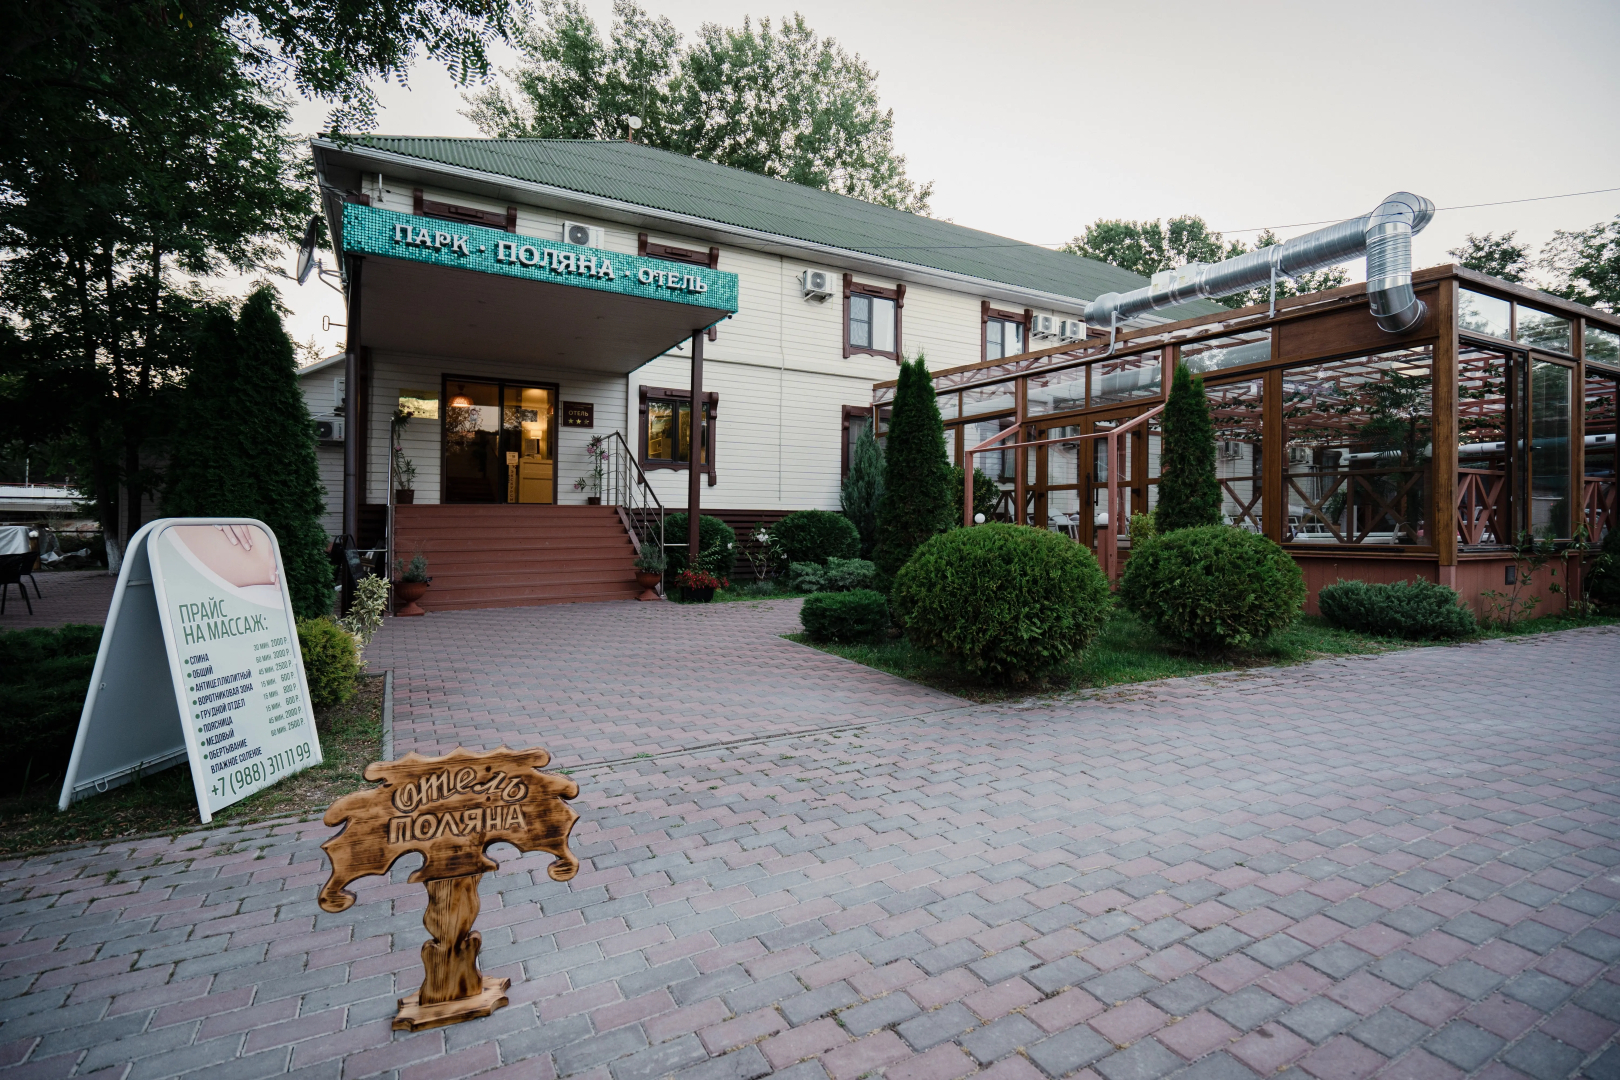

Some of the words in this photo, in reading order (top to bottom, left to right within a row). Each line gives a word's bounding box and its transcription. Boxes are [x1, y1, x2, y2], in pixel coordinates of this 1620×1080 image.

[394, 224, 470, 256] ПАРК
[497, 240, 615, 279] ПОЛЯНА
[638, 267, 708, 293] ОТЕЛЬ
[179, 596, 227, 624] ПРАЙС
[183, 624, 206, 645] НА
[206, 614, 268, 640] МАССАЖ:
[190, 653, 209, 665] СПИНА
[271, 638, 283, 647] 2000
[192, 665, 213, 678] ОБЩИЙ
[273, 650, 285, 659] 3000
[195, 669, 252, 692] АНТИЦЕЛЛЮЛИТНЫЙ
[275, 661, 288, 671] 2500
[198, 686, 239, 706] ВОРОТНИКОВАЯ
[240, 683, 253, 693] ЗОНА
[280, 672, 290, 682] 600
[201, 703, 227, 719] ГРУДНОЙ
[227, 698, 245, 711] ОТДЕЛ
[203, 716, 233, 733] ПОЯСНИЦА
[286, 696, 295, 705] 600
[206, 728, 235, 746] МЕДОВЫЙ
[285, 708, 298, 718] 2000
[209, 738, 248, 760] ОБЕРТЫВАНИЕ
[211, 756, 239, 774] ВЛАЖНОЕ
[239, 746, 262, 762] СОЛЕНОЕ
[211, 777, 225, 797] +7
[229, 760, 266, 795] (988)
[267, 753, 285, 776] 311
[285, 748, 295, 767] 11
[295, 742, 311, 762] 99
[388, 803, 528, 844] ПОЛЯНА
